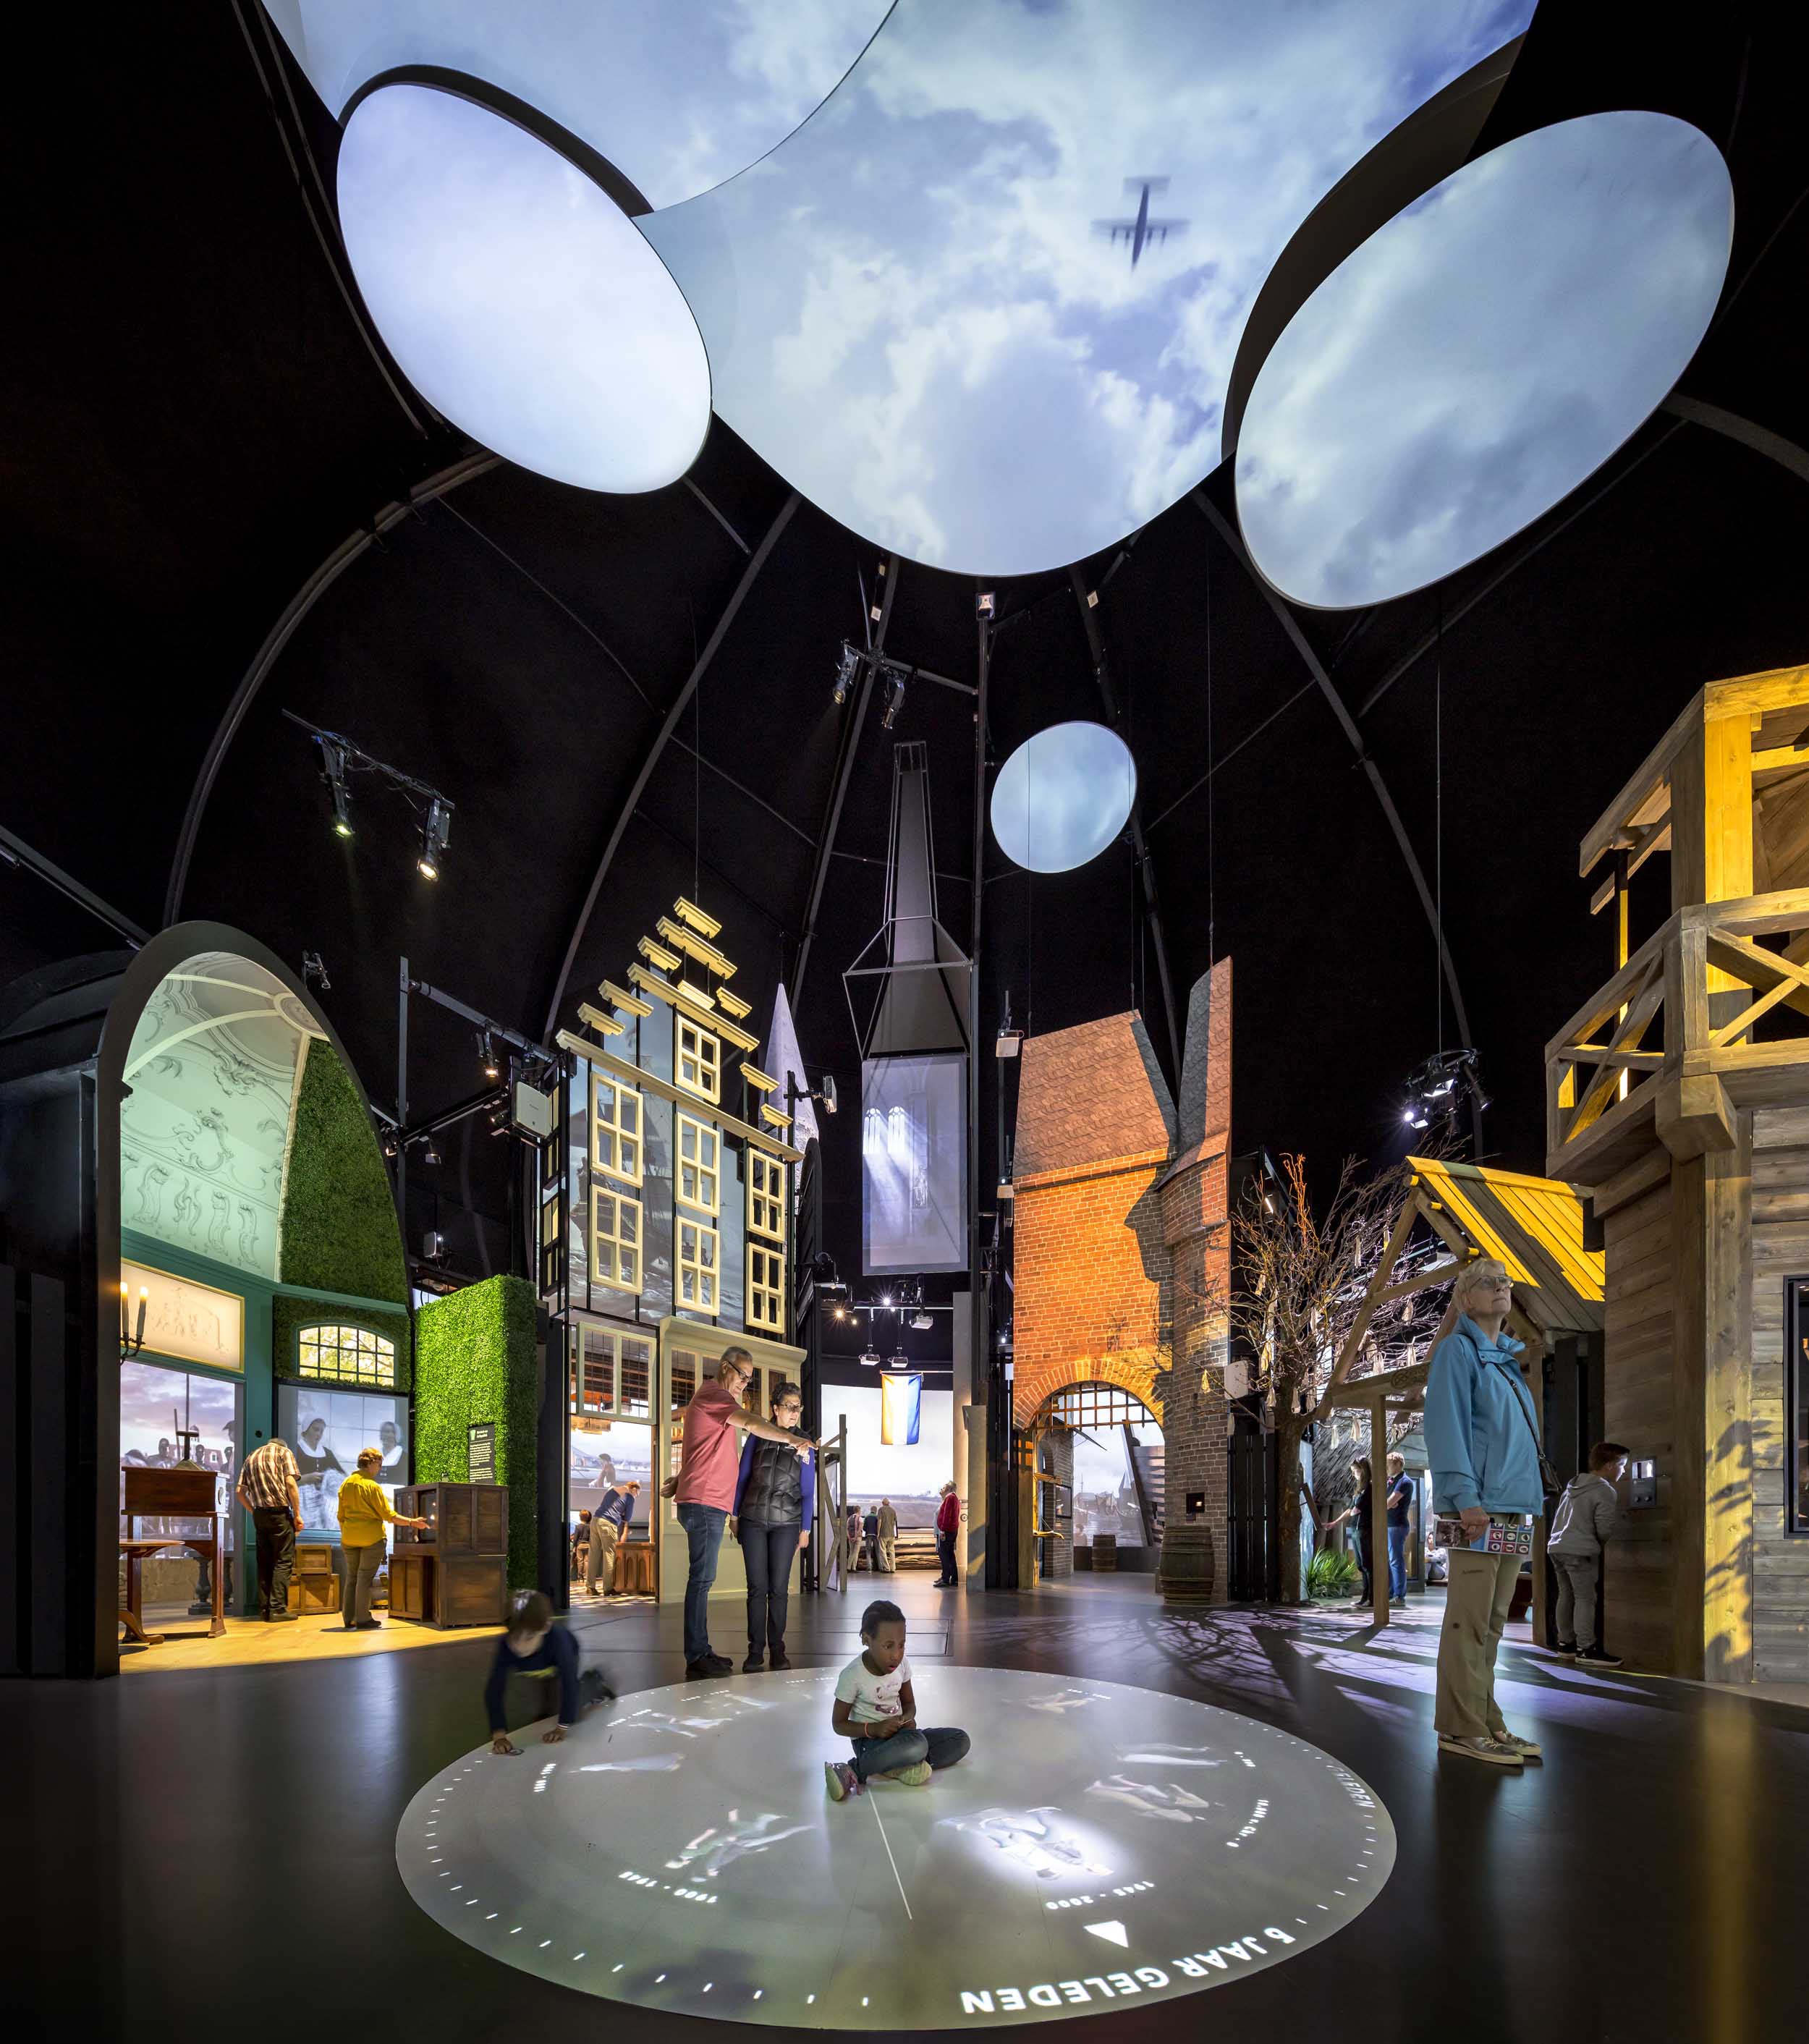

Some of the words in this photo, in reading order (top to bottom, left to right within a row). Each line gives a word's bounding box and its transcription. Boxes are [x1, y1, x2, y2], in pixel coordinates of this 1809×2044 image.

[1046, 1895, 1095, 1911] 2000
[1172, 1936, 1268, 1977] JAAR
[960, 1967, 1169, 2014] GELEDEN
